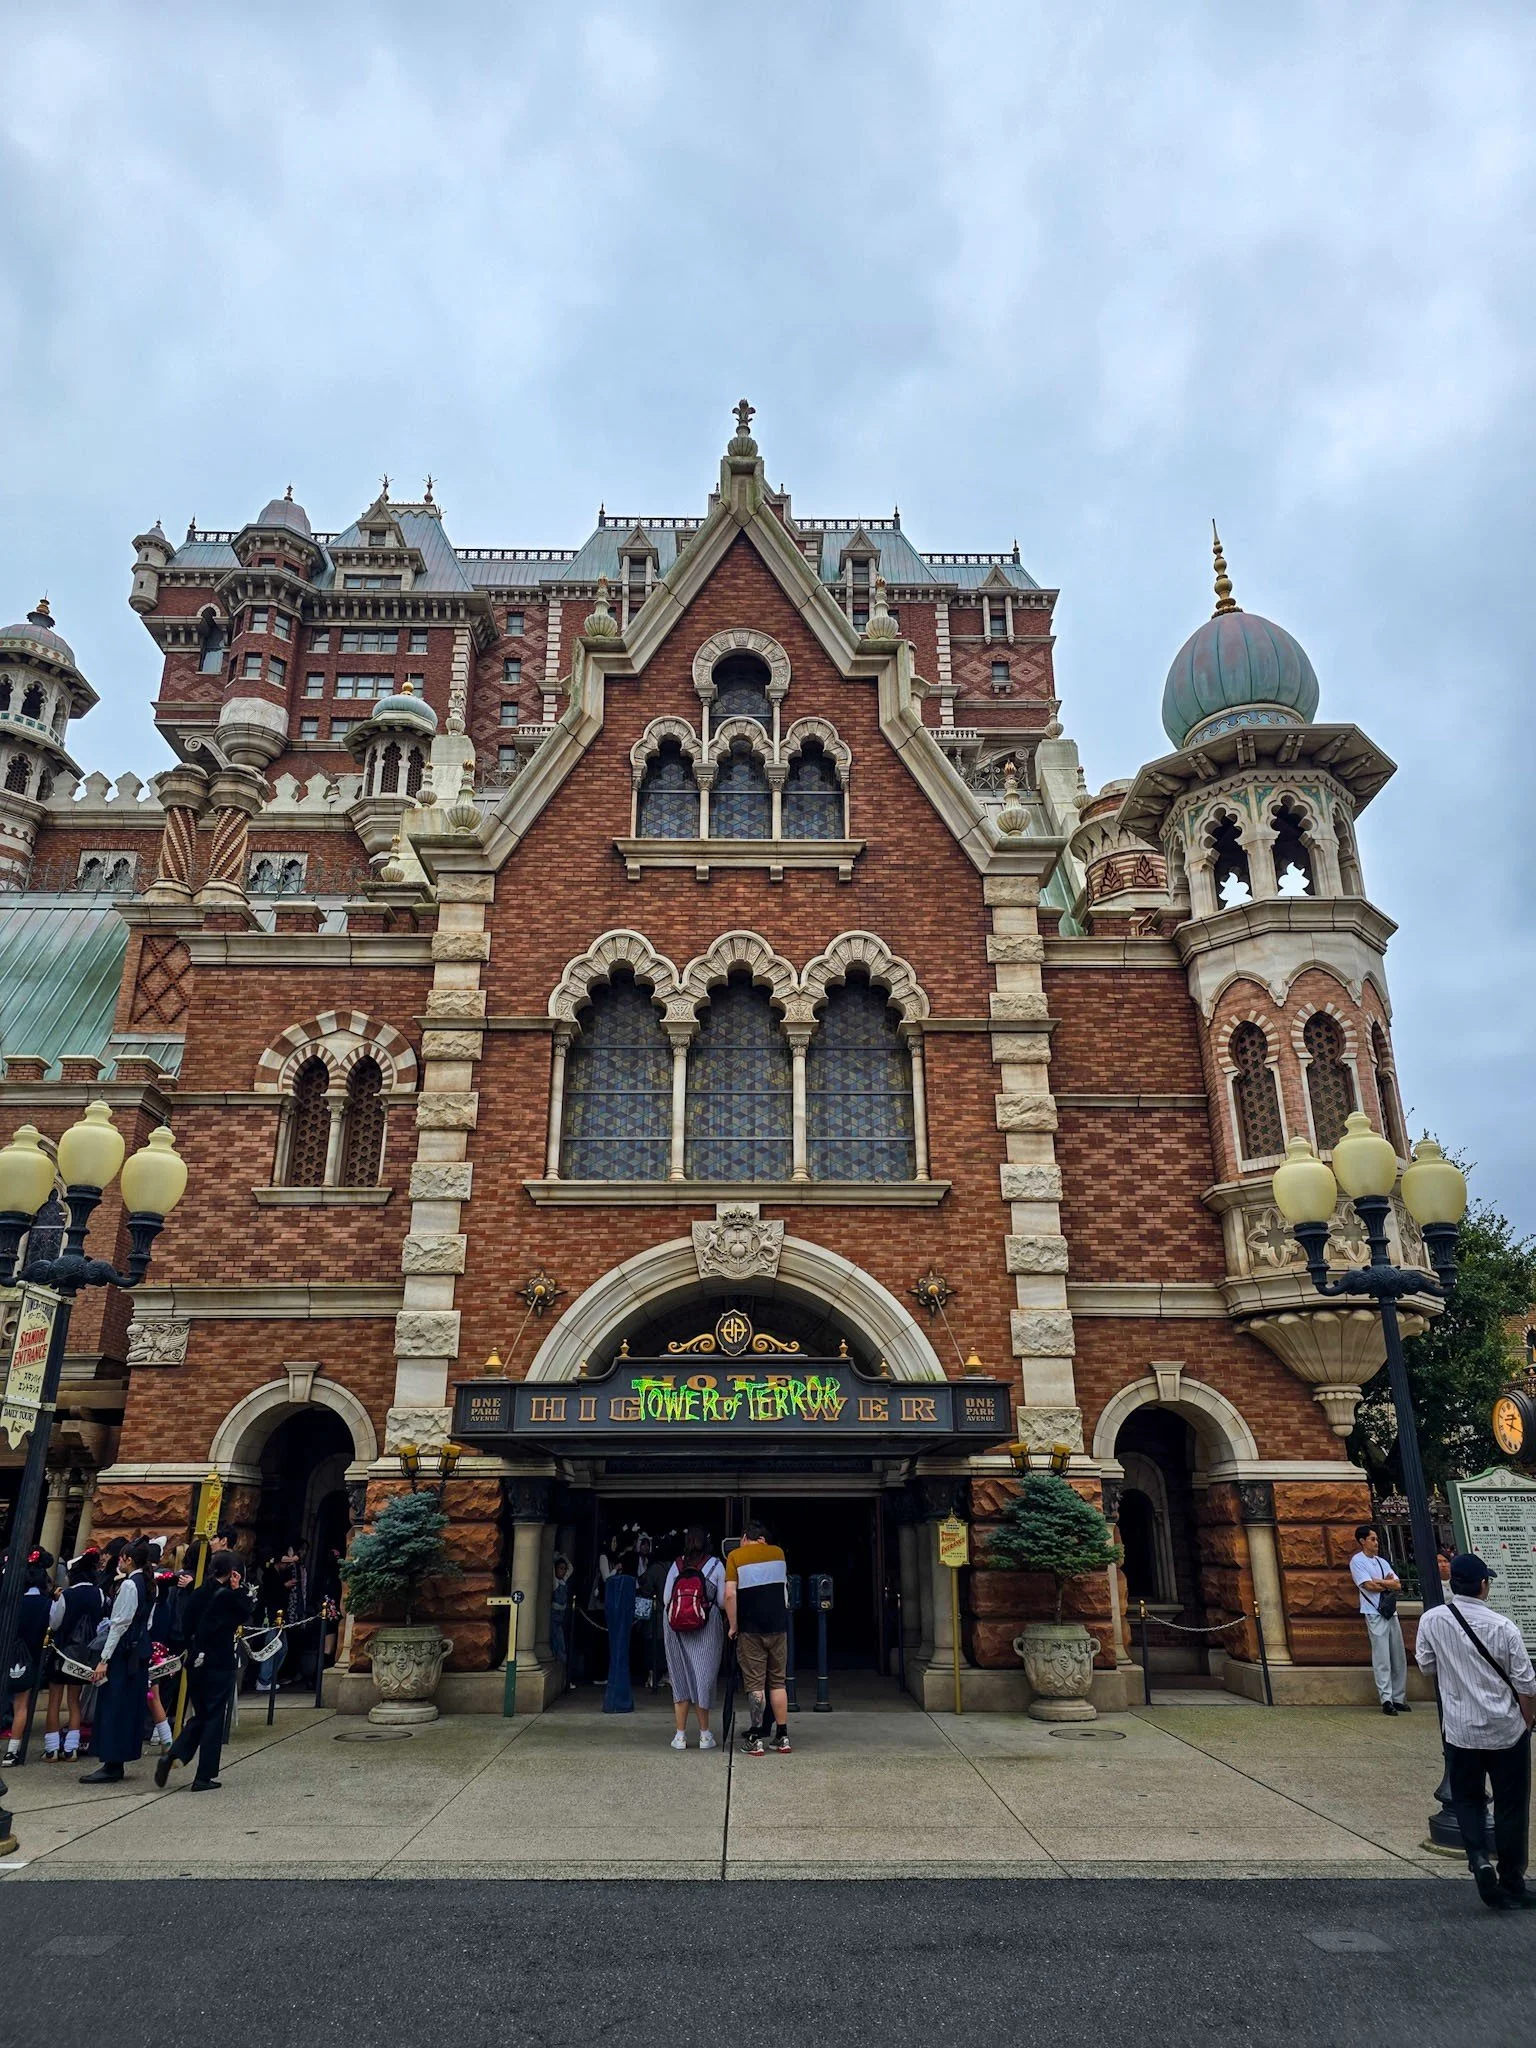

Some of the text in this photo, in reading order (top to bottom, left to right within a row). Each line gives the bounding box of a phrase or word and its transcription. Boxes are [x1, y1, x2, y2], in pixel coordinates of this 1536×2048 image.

[13, 1343, 48, 1368] ENTRANCE
[471, 1397, 502, 1408] ONE
[631, 1376, 841, 1423] TOWER of TERROR
[965, 1397, 995, 1408] ONE
[471, 1407, 500, 1416] PARK
[966, 1407, 995, 1416] PARK
[1467, 1495, 1501, 1503] TOWER
[1498, 1525, 1526, 1533] WARNING!
